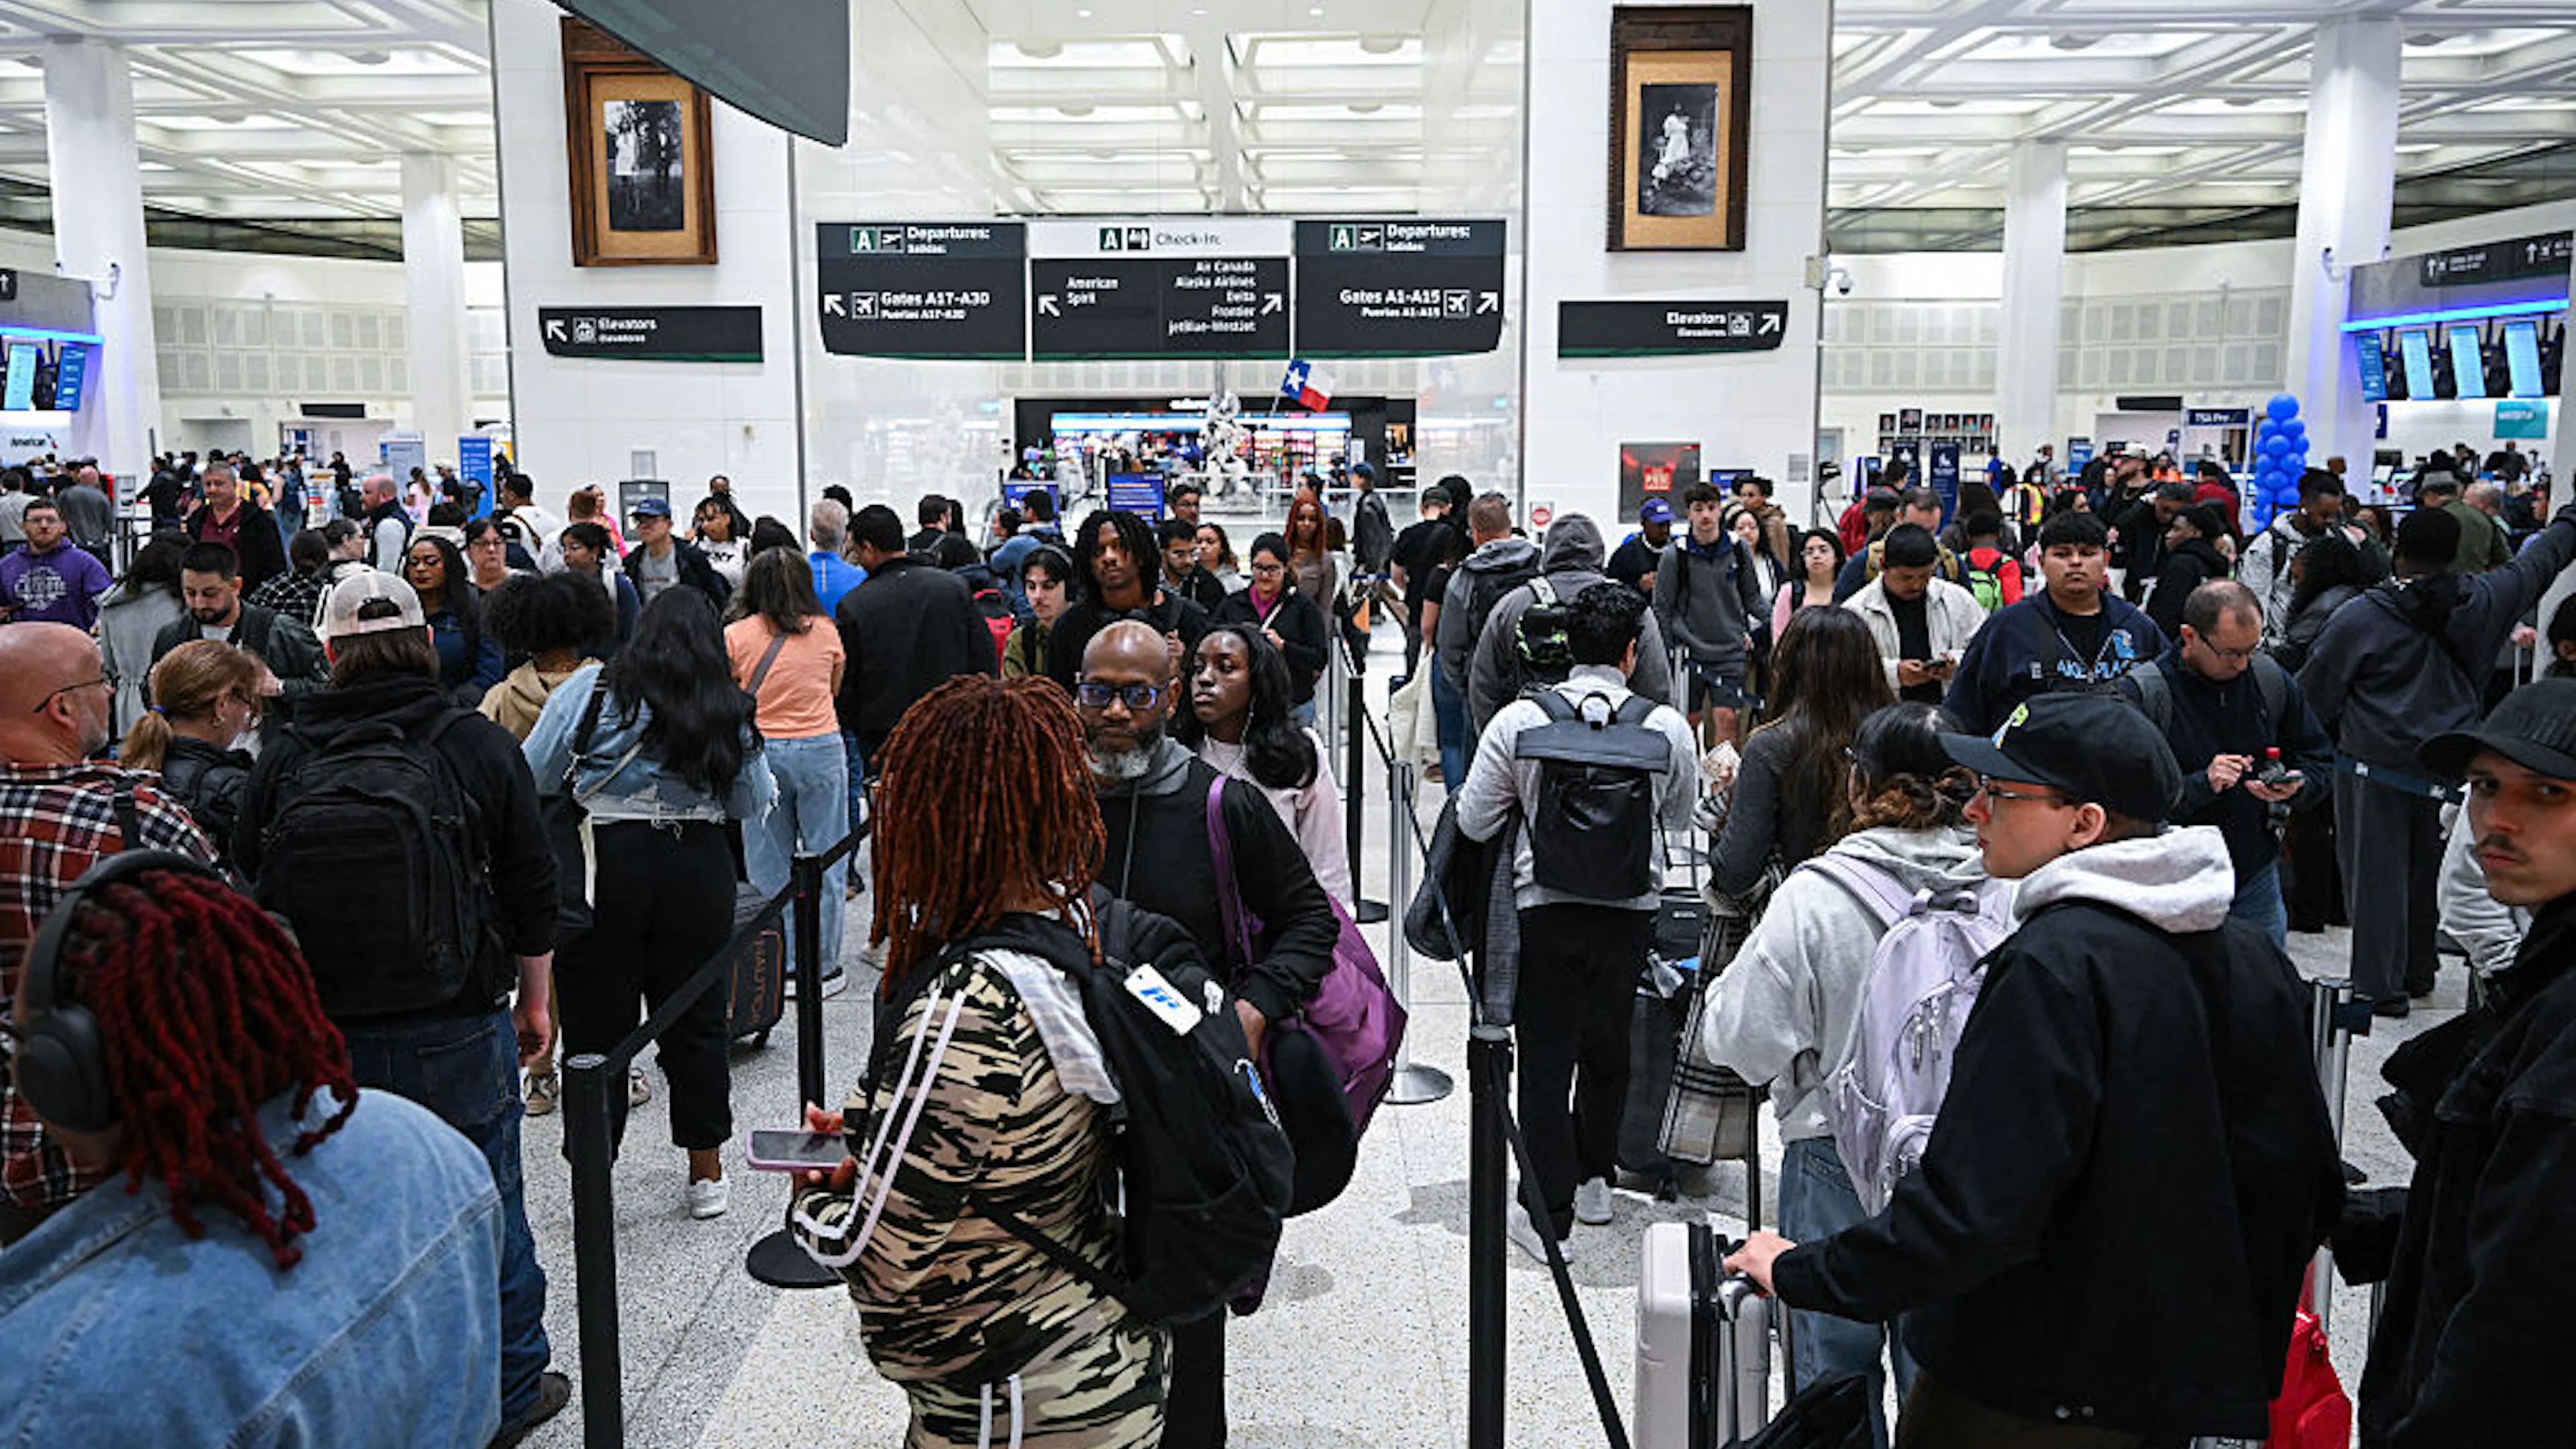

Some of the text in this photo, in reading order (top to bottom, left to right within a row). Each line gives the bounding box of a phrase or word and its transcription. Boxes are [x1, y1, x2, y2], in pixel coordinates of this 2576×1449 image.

[857, 226, 991, 250] A Departures:
[1103, 229, 1118, 249] A
[1335, 223, 1470, 248] A Departures:
[1213, 260, 1256, 273] Canada
[1067, 277, 1118, 289] American
[1174, 274, 1256, 289] Alaska Airlines
[881, 291, 991, 307] Gates A17-A30
[1067, 291, 1096, 307] Spirit
[1226, 290, 1256, 303] Delta
[1340, 288, 1440, 305] Gates A1-A15
[1211, 304, 1256, 317] Frontier
